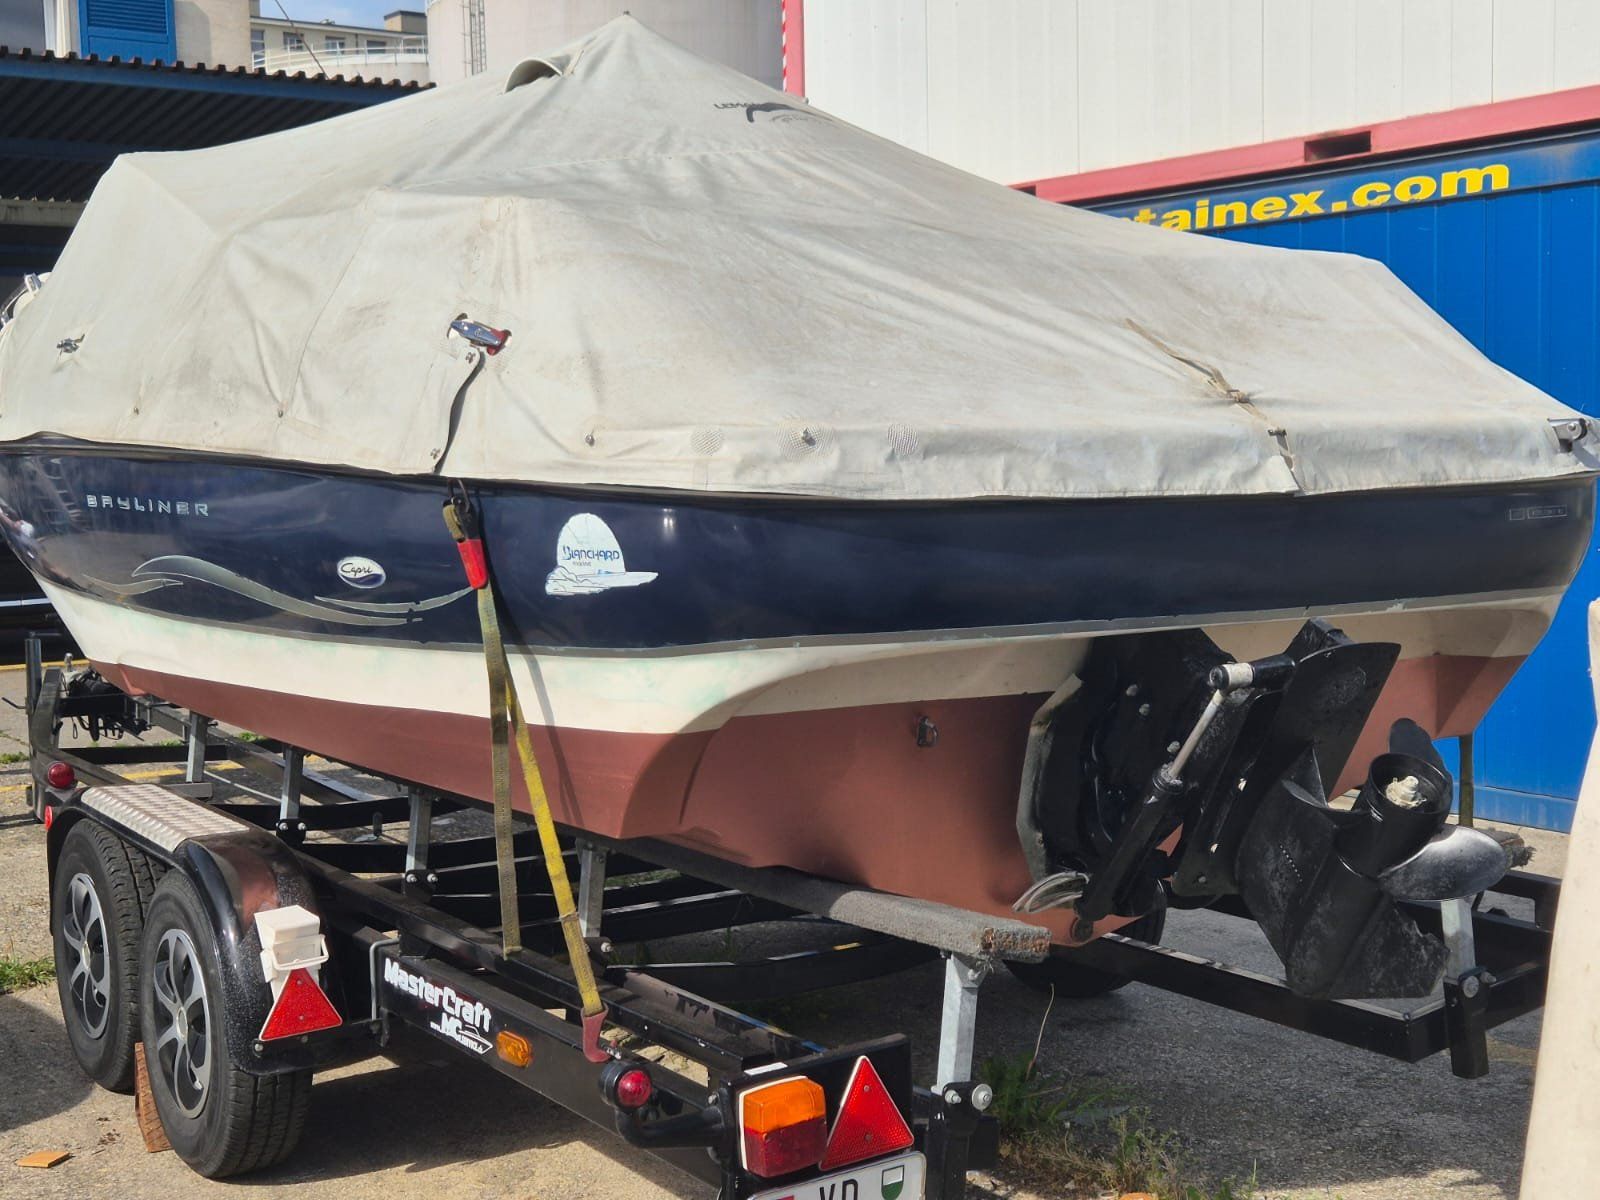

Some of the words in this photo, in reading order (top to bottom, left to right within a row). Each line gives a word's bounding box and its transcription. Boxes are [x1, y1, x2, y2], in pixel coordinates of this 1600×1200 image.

[1120, 162, 1509, 232] tainex.com
[86, 494, 209, 517] BAYLINER
[340, 562, 373, 576] Capri
[384, 957, 492, 1033] MasterCraft
